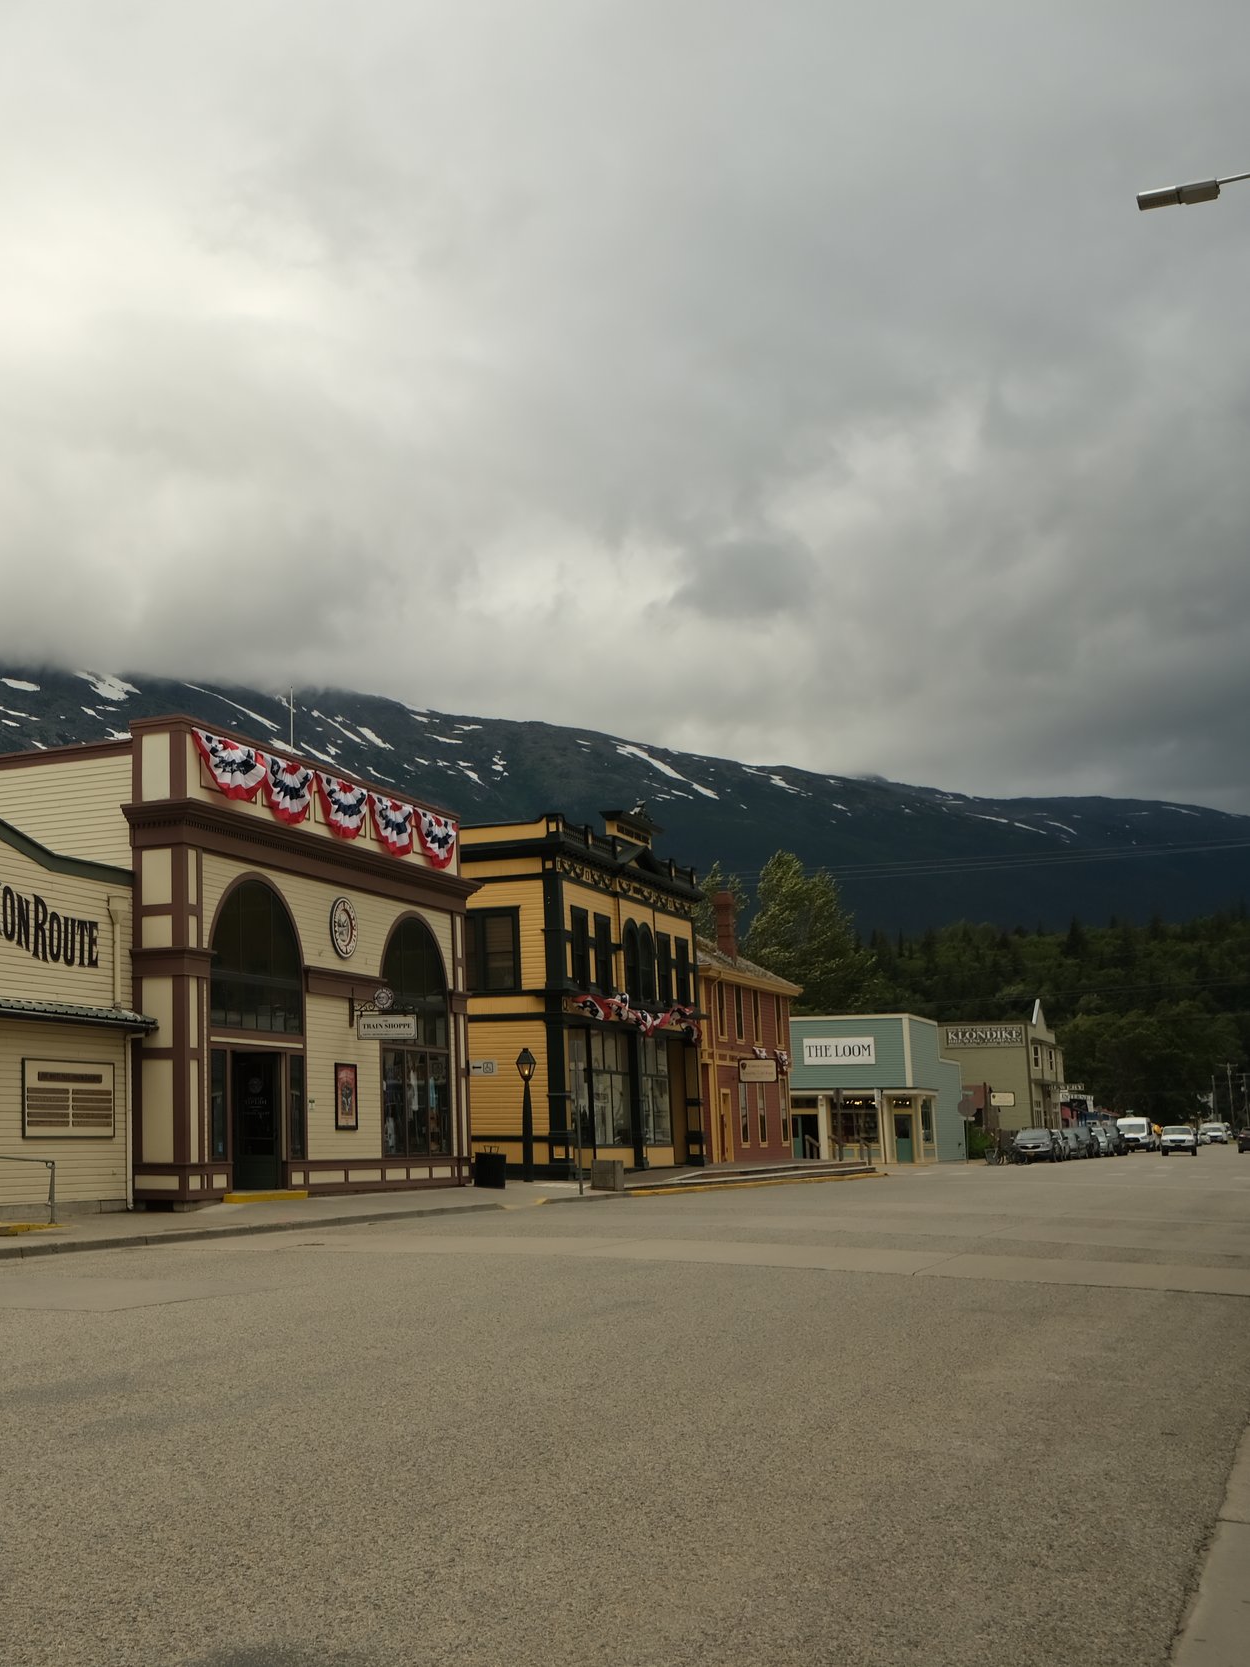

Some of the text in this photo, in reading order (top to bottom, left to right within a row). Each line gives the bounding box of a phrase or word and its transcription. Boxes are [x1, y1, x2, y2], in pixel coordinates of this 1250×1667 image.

[31, 893, 99, 968] ROUTE
[948, 1030, 1021, 1040] KLONDIKE
[805, 1044, 871, 1058] THE LOOM
